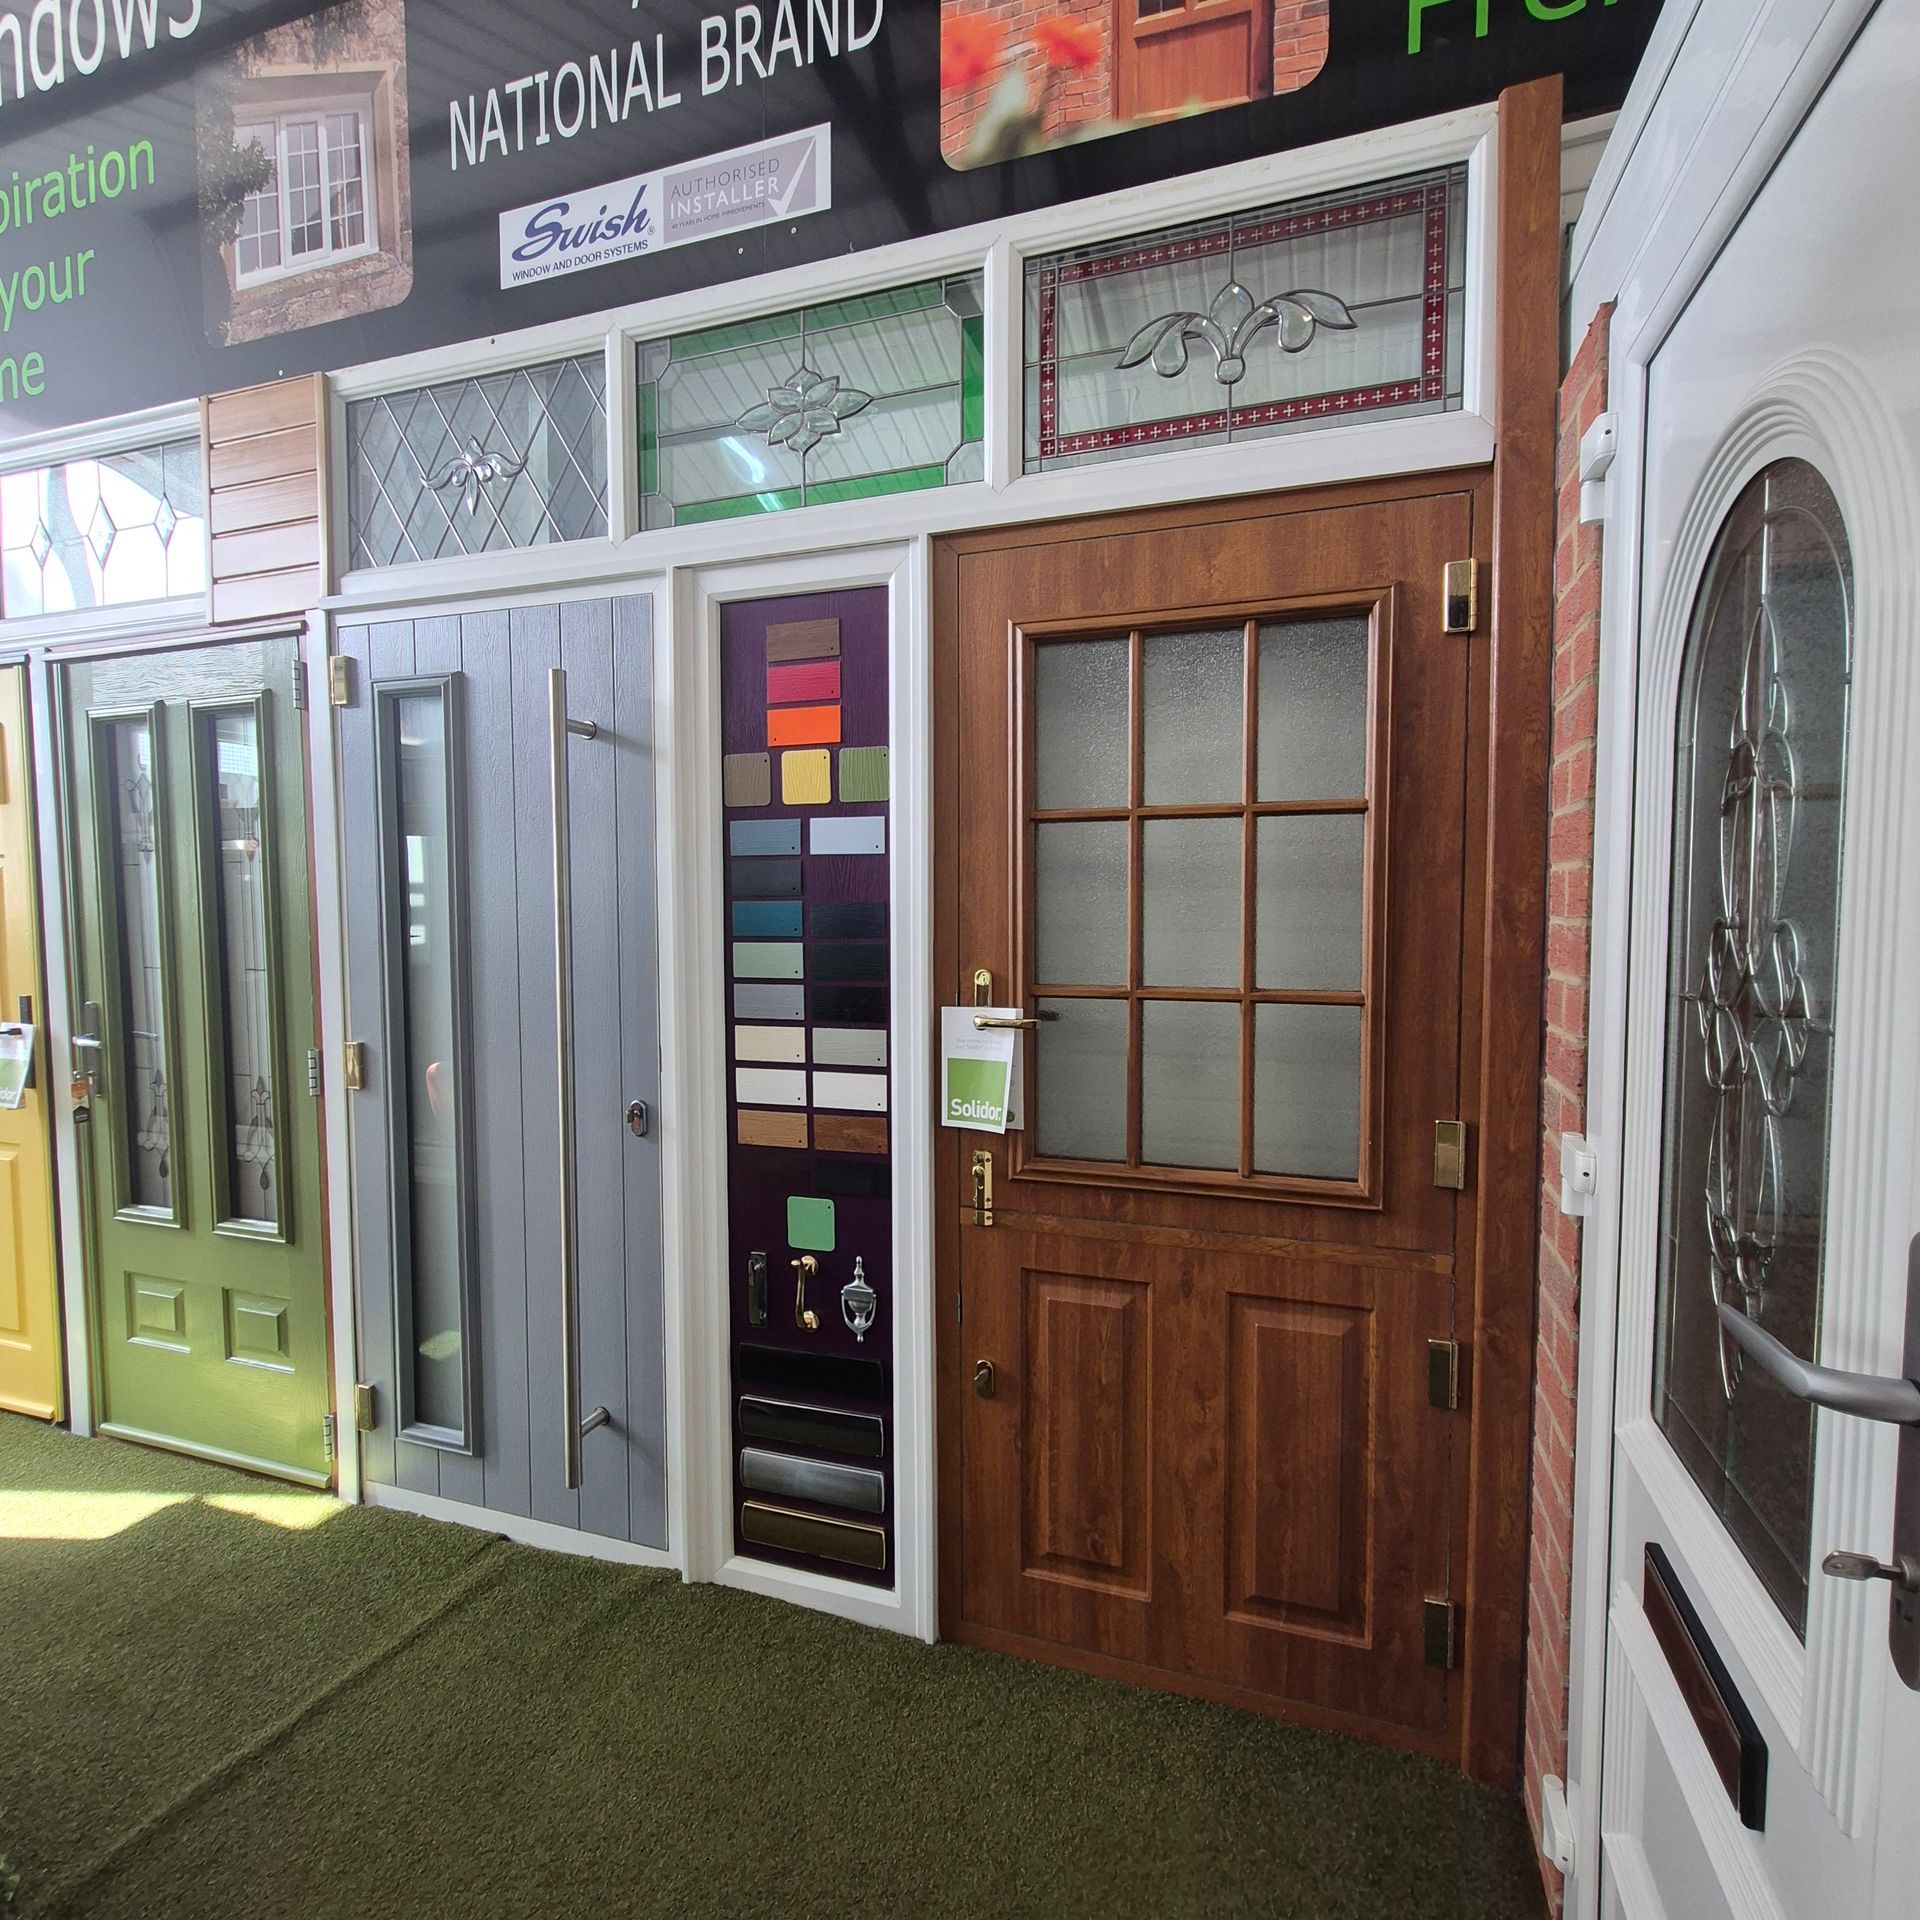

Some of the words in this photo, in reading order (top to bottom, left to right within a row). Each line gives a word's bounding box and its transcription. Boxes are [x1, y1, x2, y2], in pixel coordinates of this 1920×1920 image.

[450, 33, 681, 170] NATIONAL
[701, 0, 883, 96] BRAND
[670, 177, 779, 220] INSTALLER
[671, 158, 780, 199] AUTHORISED
[512, 184, 650, 261] Swish
[679, 219, 695, 229] YEARS
[696, 217, 703, 225] IN
[703, 213, 720, 222] HOME
[721, 202, 766, 217] IMPROVEMENTS
[512, 264, 550, 281] WINDOW
[553, 259, 572, 272] AND
[574, 252, 601, 266] DOOR
[603, 239, 648, 259] SYSTEMS
[0, 249, 94, 332] your
